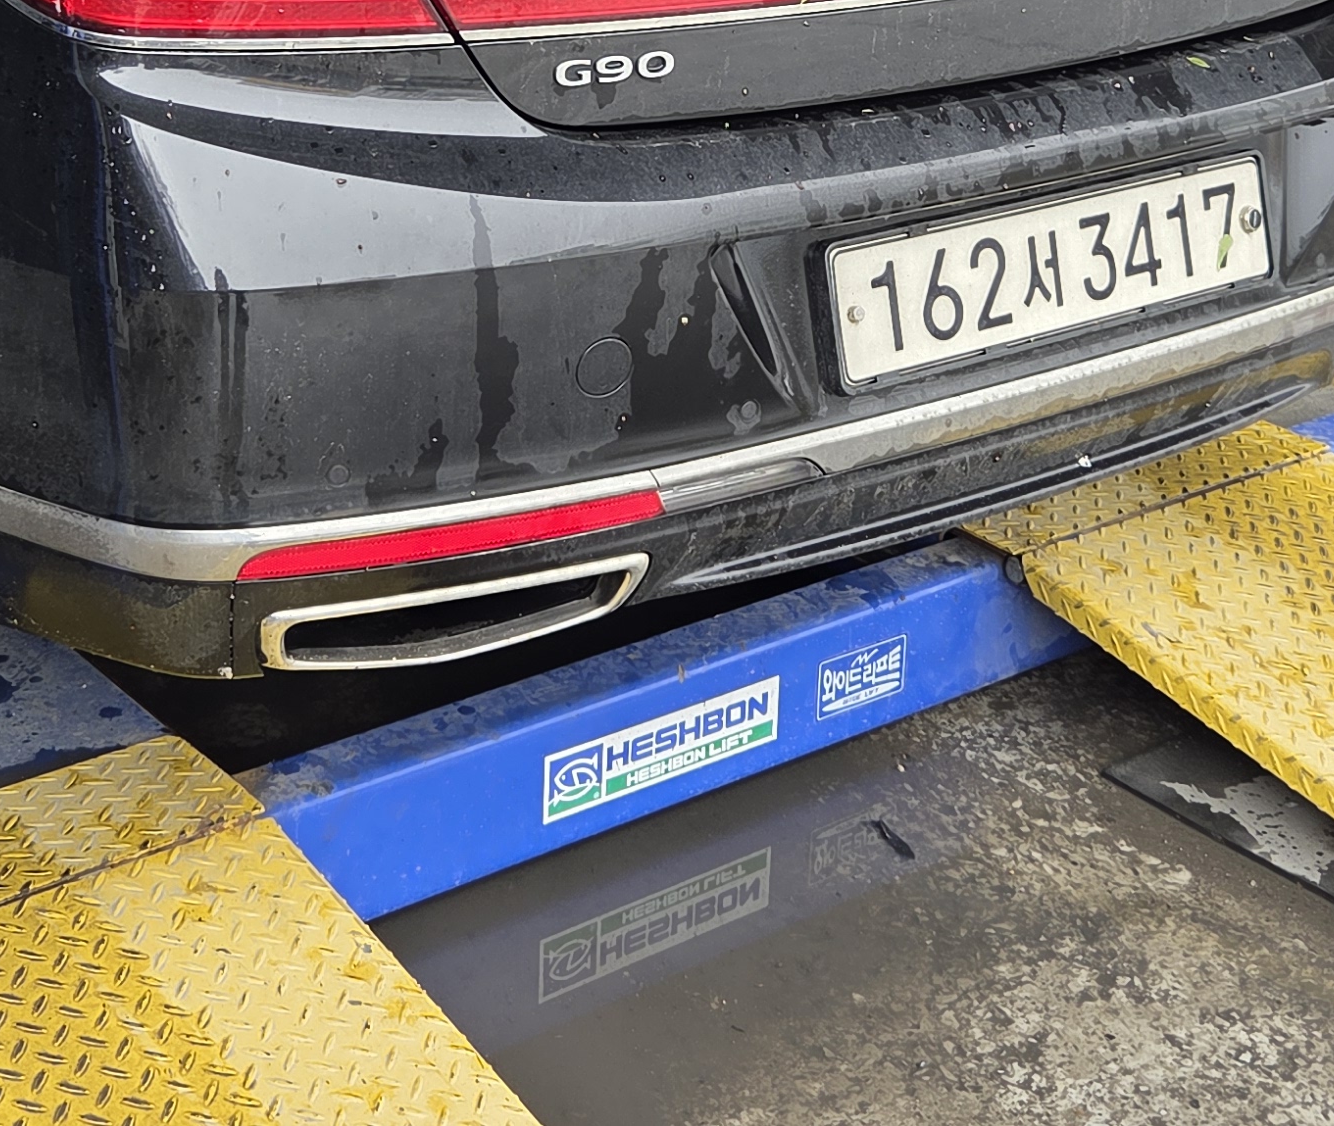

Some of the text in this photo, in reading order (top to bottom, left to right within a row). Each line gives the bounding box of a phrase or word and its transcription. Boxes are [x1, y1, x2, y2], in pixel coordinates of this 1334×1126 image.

[554, 50, 675, 88] G90
[870, 182, 1238, 353] 162서3417
[606, 691, 770, 773] HESHBON
[625, 728, 754, 788] HESHBON LIFT
